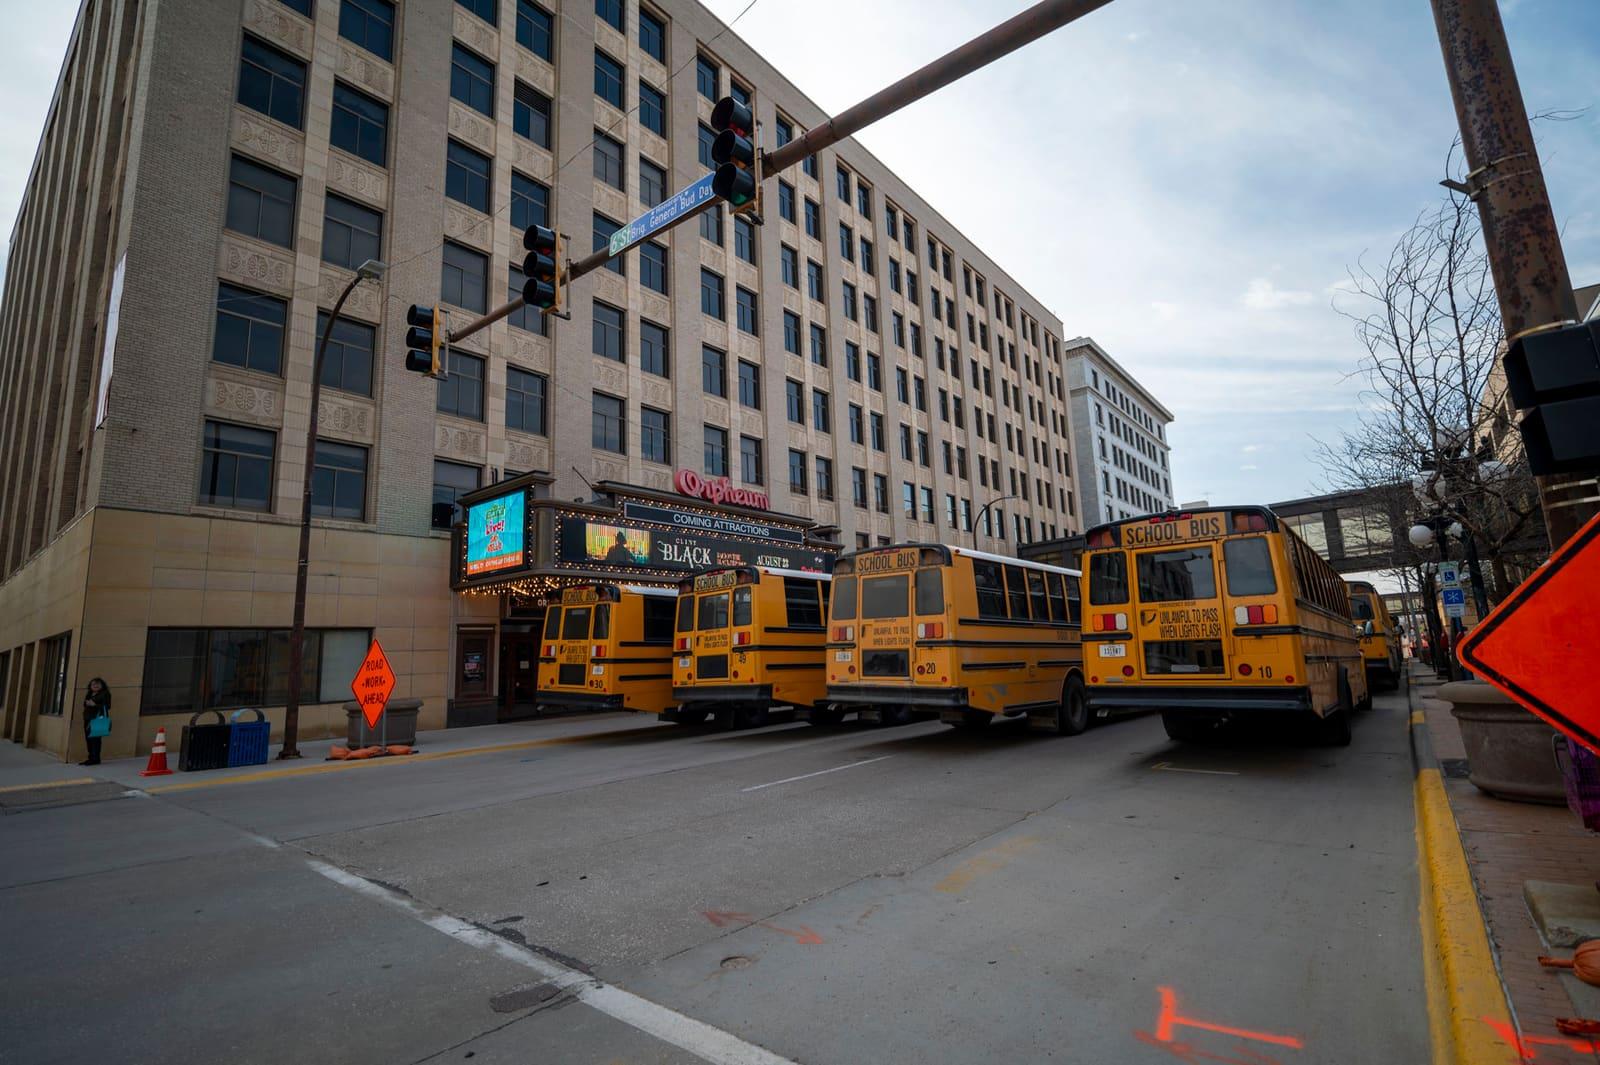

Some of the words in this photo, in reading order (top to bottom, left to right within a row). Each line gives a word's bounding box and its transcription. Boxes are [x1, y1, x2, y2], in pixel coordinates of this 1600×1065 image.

[650, 204, 677, 227] General
[680, 192, 695, 209] Bud
[699, 184, 713, 199] Day
[621, 230, 631, 246] St
[674, 469, 770, 510] Orpheum
[673, 513, 712, 528] COMING
[713, 521, 770, 536] ATTRACTIONS
[1126, 523, 1183, 545] SCHOOL
[1190, 517, 1221, 537] BUS
[676, 537, 697, 546] CLINT
[657, 541, 713, 569] BLACK
[757, 555, 781, 567] AUGUST
[858, 554, 893, 572] SCHOOL
[896, 551, 916, 568] BUS
[696, 576, 719, 590] SCHOOL
[721, 573, 735, 586] BUS
[1160, 609, 1192, 625] UNLAWFUL
[1192, 609, 1201, 623] TO
[1202, 608, 1219, 622] PASS
[1160, 624, 1178, 639] WHEN
[1178, 624, 1200, 638] LIGHTS
[1201, 623, 1222, 639] FLASH
[366, 659, 384, 671] ROAD
[926, 662, 936, 675] 20
[1258, 666, 1272, 679] 10
[365, 676, 384, 688] WORK
[594, 680, 603, 689] 30
[364, 692, 385, 704] AHEAD
